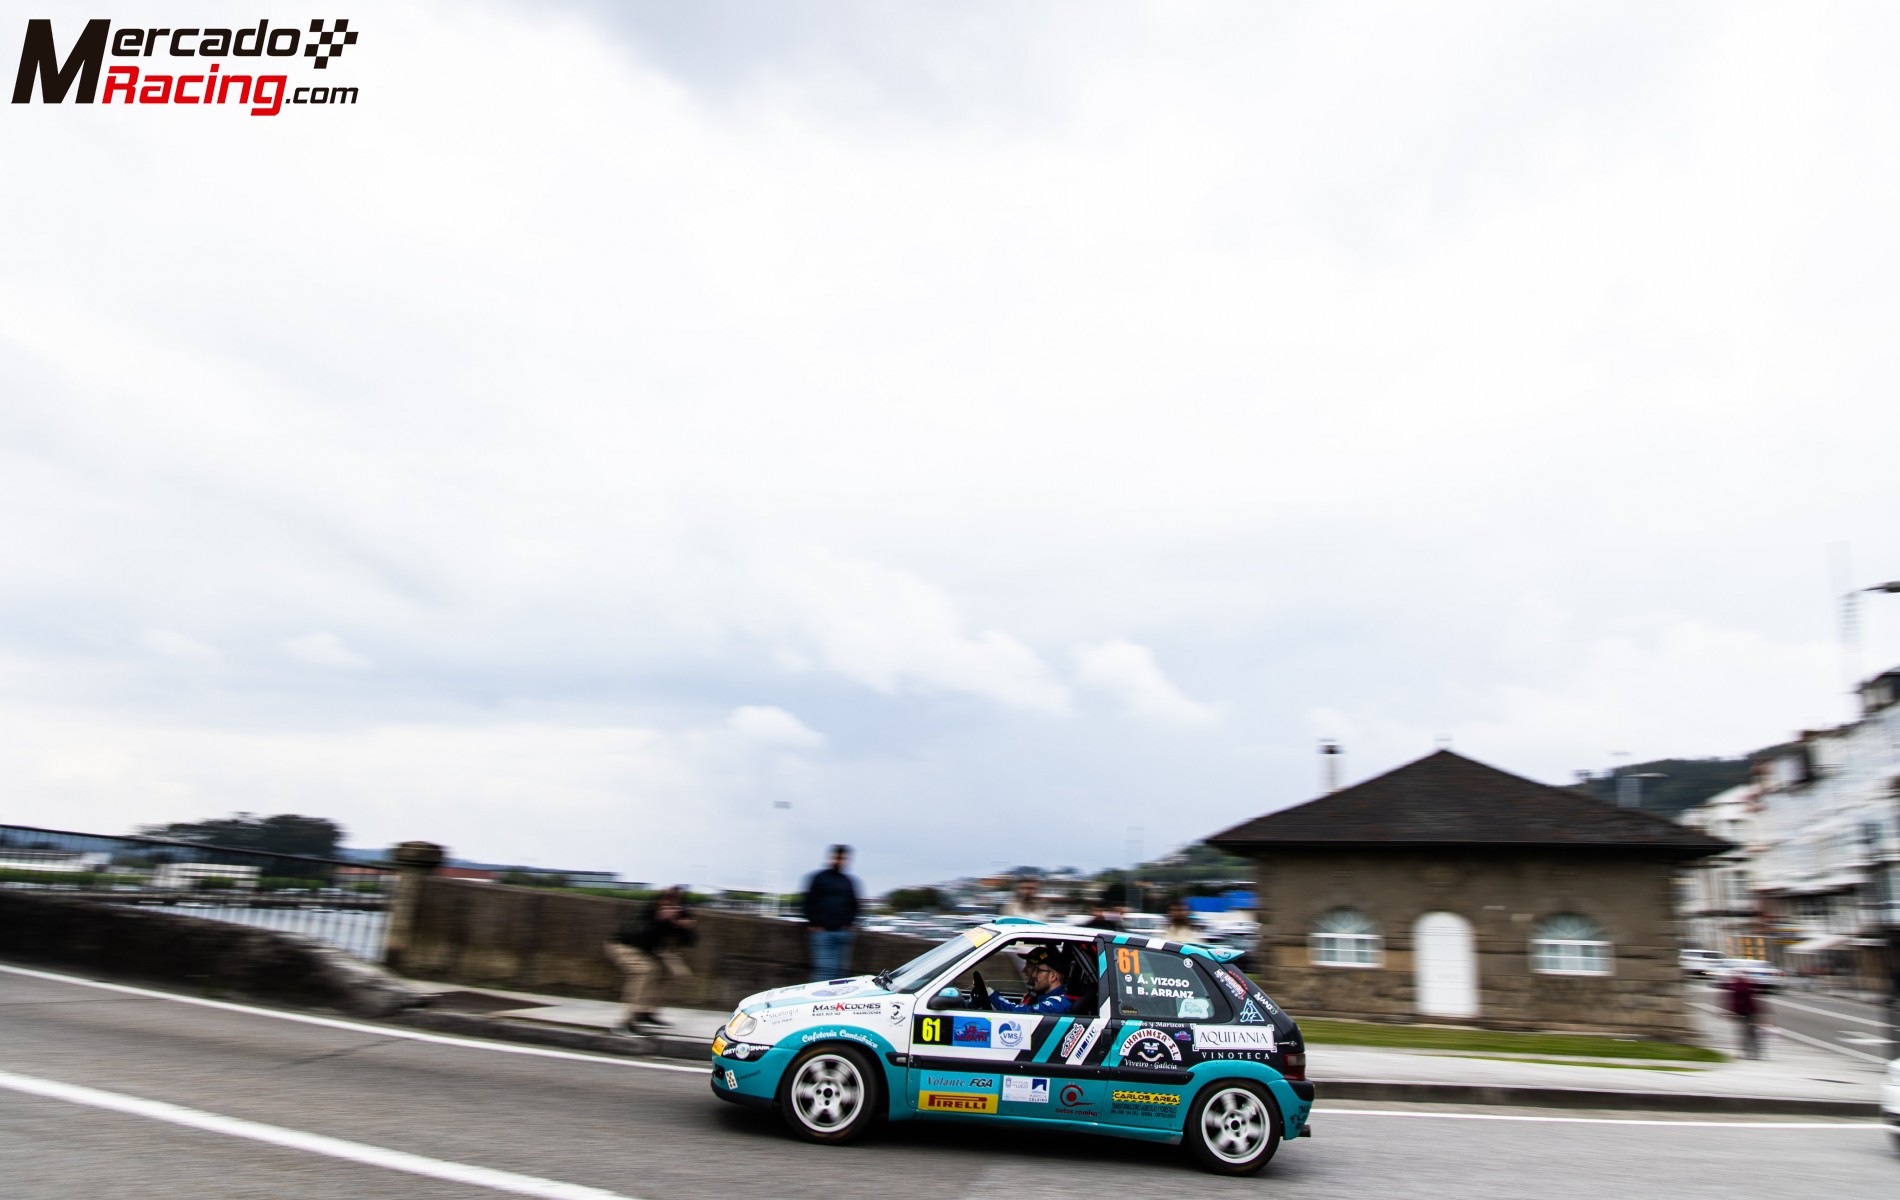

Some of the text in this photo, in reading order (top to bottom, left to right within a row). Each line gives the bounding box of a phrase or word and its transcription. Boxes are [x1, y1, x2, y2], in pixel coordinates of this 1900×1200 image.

[1117, 948, 1141, 975] 61
[1150, 976, 1190, 988] VIZOSO
[1137, 987, 1194, 999] B. ARRANZ
[922, 1017, 941, 1042] 61
[1002, 1032, 1019, 1040] VMS
[1199, 1031, 1269, 1045] AQUITANIA
[1202, 1052, 1270, 1060] VINOTECA
[1124, 1058, 1149, 1068] Viveiro
[1153, 1061, 1178, 1070] Galicia
[927, 1076, 993, 1088] Volante FGA
[928, 1094, 988, 1110] PIRELLI
[1114, 1093, 1179, 1103] CARLOS AREA
